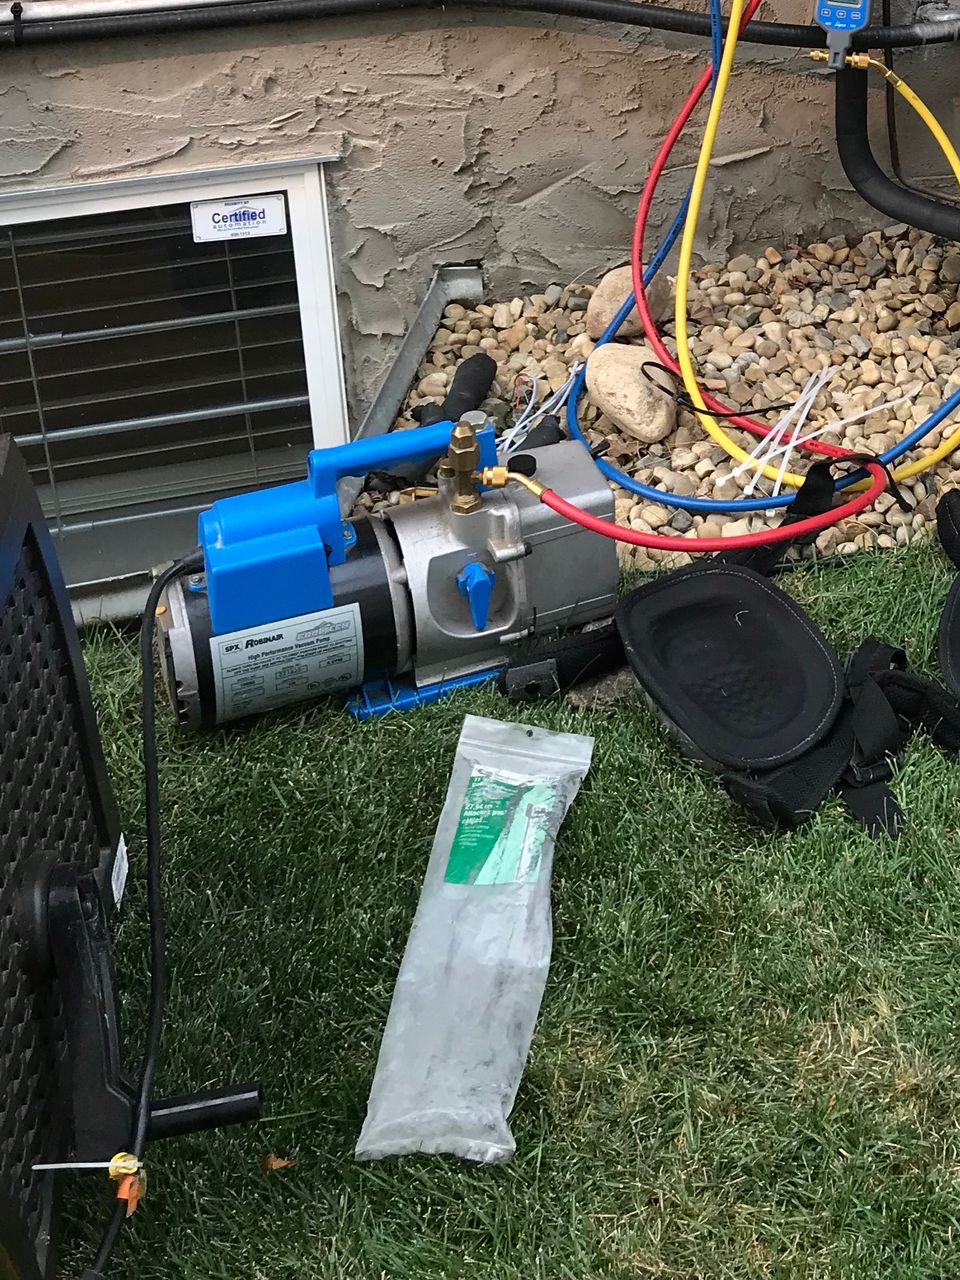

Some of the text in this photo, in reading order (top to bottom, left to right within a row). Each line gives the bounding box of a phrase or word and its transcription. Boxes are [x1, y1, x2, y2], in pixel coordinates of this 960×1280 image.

[212, 208, 266, 224] Certified
[212, 220, 267, 230] automation
[225, 644, 240, 653] SPX
[245, 633, 284, 650] ROBINAIR
[248, 654, 260, 662] High
[261, 646, 294, 658] Performance
[294, 640, 315, 650] Vacuum
[316, 636, 331, 645] Pump
